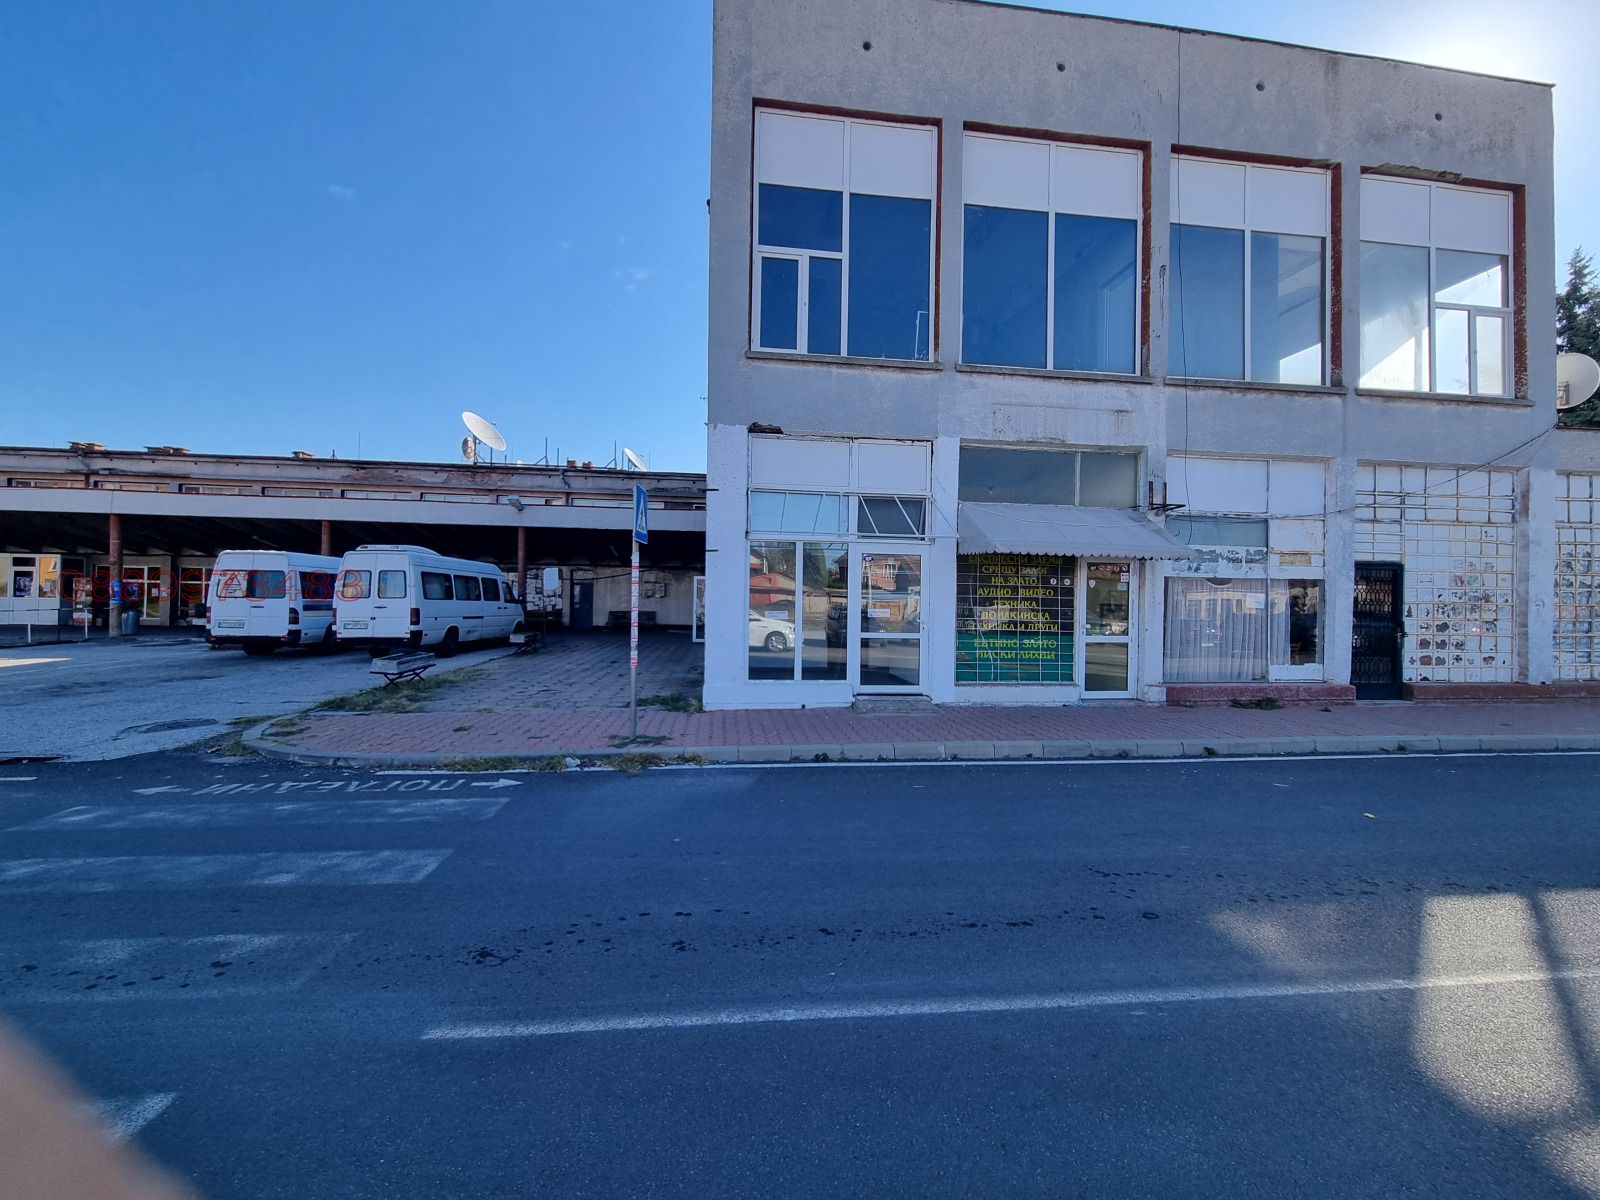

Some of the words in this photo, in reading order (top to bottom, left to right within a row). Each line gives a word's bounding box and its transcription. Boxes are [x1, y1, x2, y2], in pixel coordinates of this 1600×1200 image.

[968, 554, 1028, 563] ЕКСПРЕСНИ
[1030, 555, 1063, 565] ЗАЕМИ
[982, 565, 1018, 575] СРЕЩУ
[1020, 566, 1050, 575] ЗАЛОГ
[991, 576, 1005, 585] НА
[978, 588, 1012, 597] АУДИО
[1020, 588, 1054, 597] ВИДЕО
[993, 600, 1037, 608] ТЕХНИКА
[980, 610, 1051, 620] ДОМАКИНСКА
[1028, 623, 1059, 632] ДРУГИ
[974, 639, 1019, 648] ЕВТИНО
[1022, 639, 1057, 648] ЗЛАТО
[976, 650, 1016, 659] НИСКИ
[1019, 651, 1056, 660] ЛИХВИ
